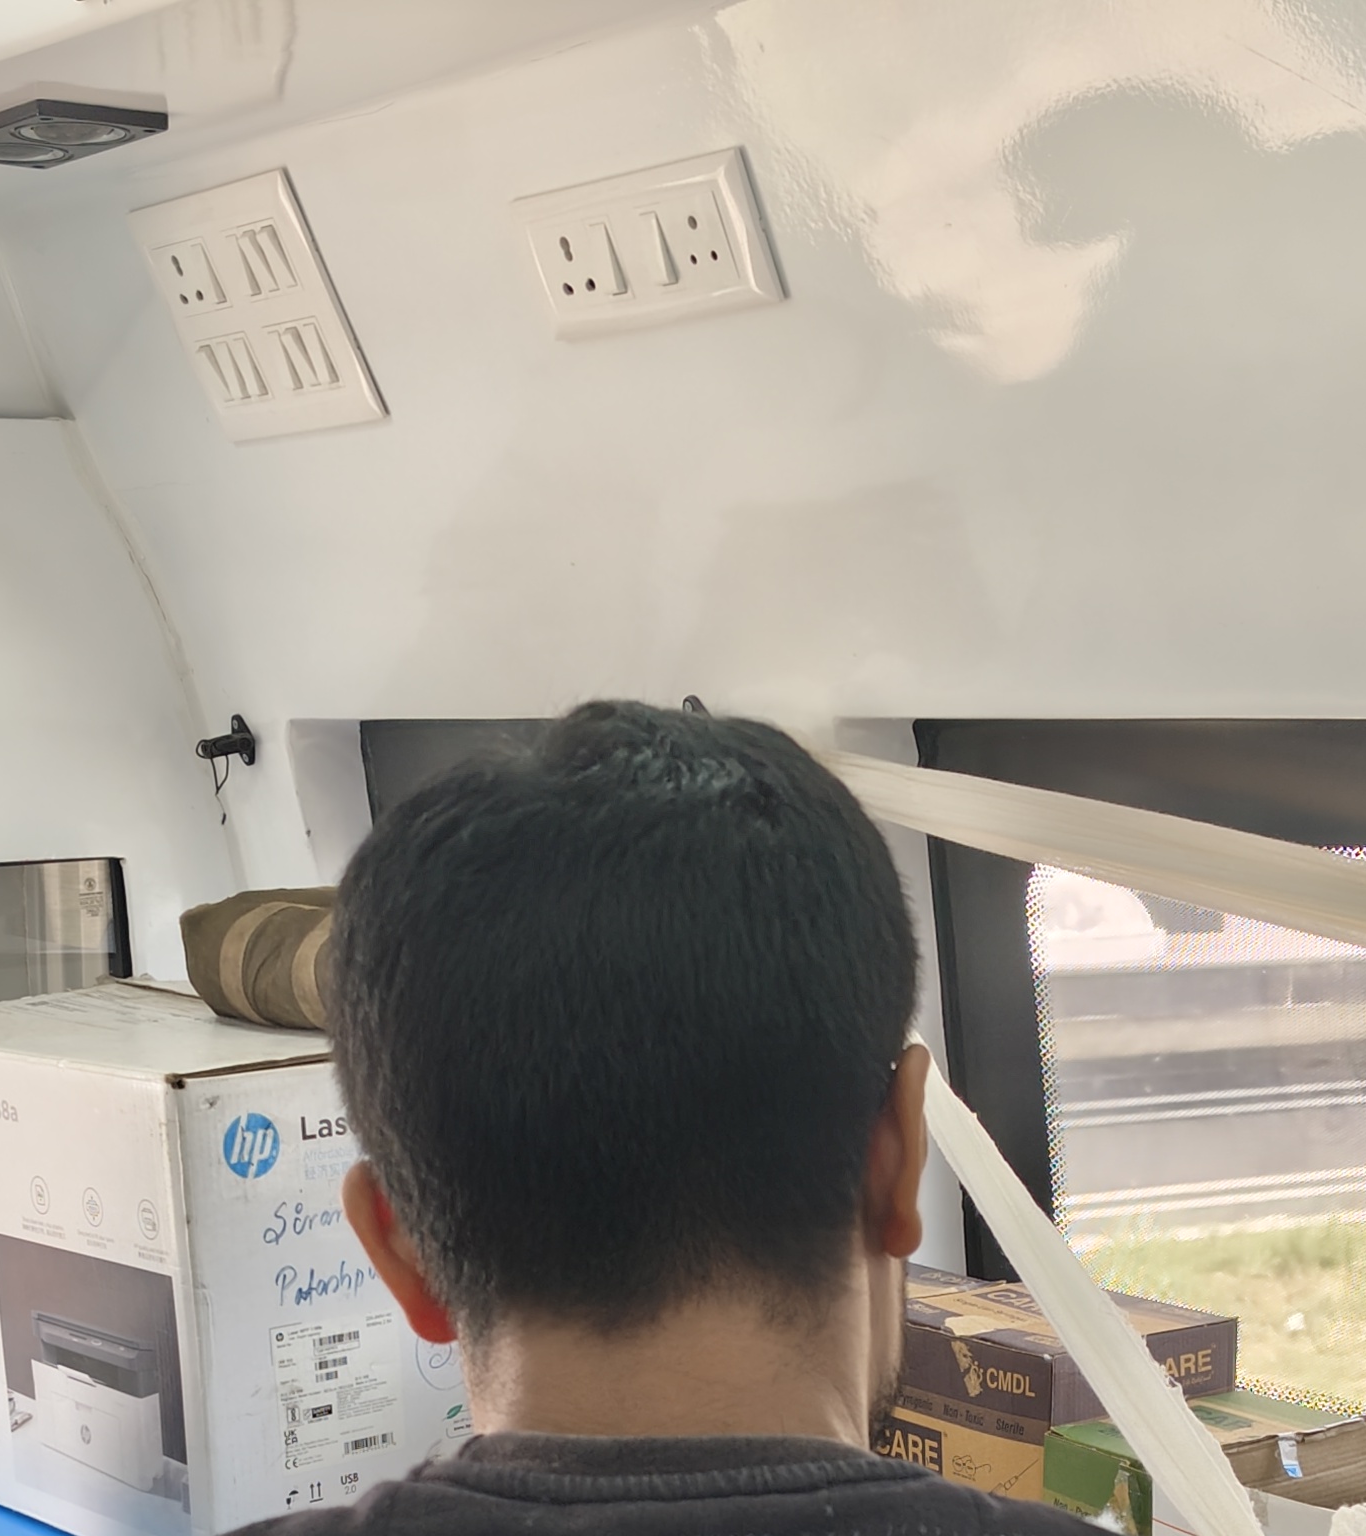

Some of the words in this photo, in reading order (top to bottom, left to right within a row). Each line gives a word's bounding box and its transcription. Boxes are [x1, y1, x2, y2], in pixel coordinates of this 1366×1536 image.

[300, 1116, 348, 1141] Las
[1165, 1349, 1212, 1378] ARE
[986, 1367, 1036, 1397] CMDL
[995, 1418, 1025, 1436] Sterile
[340, 1472, 359, 1486] USB
[344, 1485, 357, 1495] 2.0
